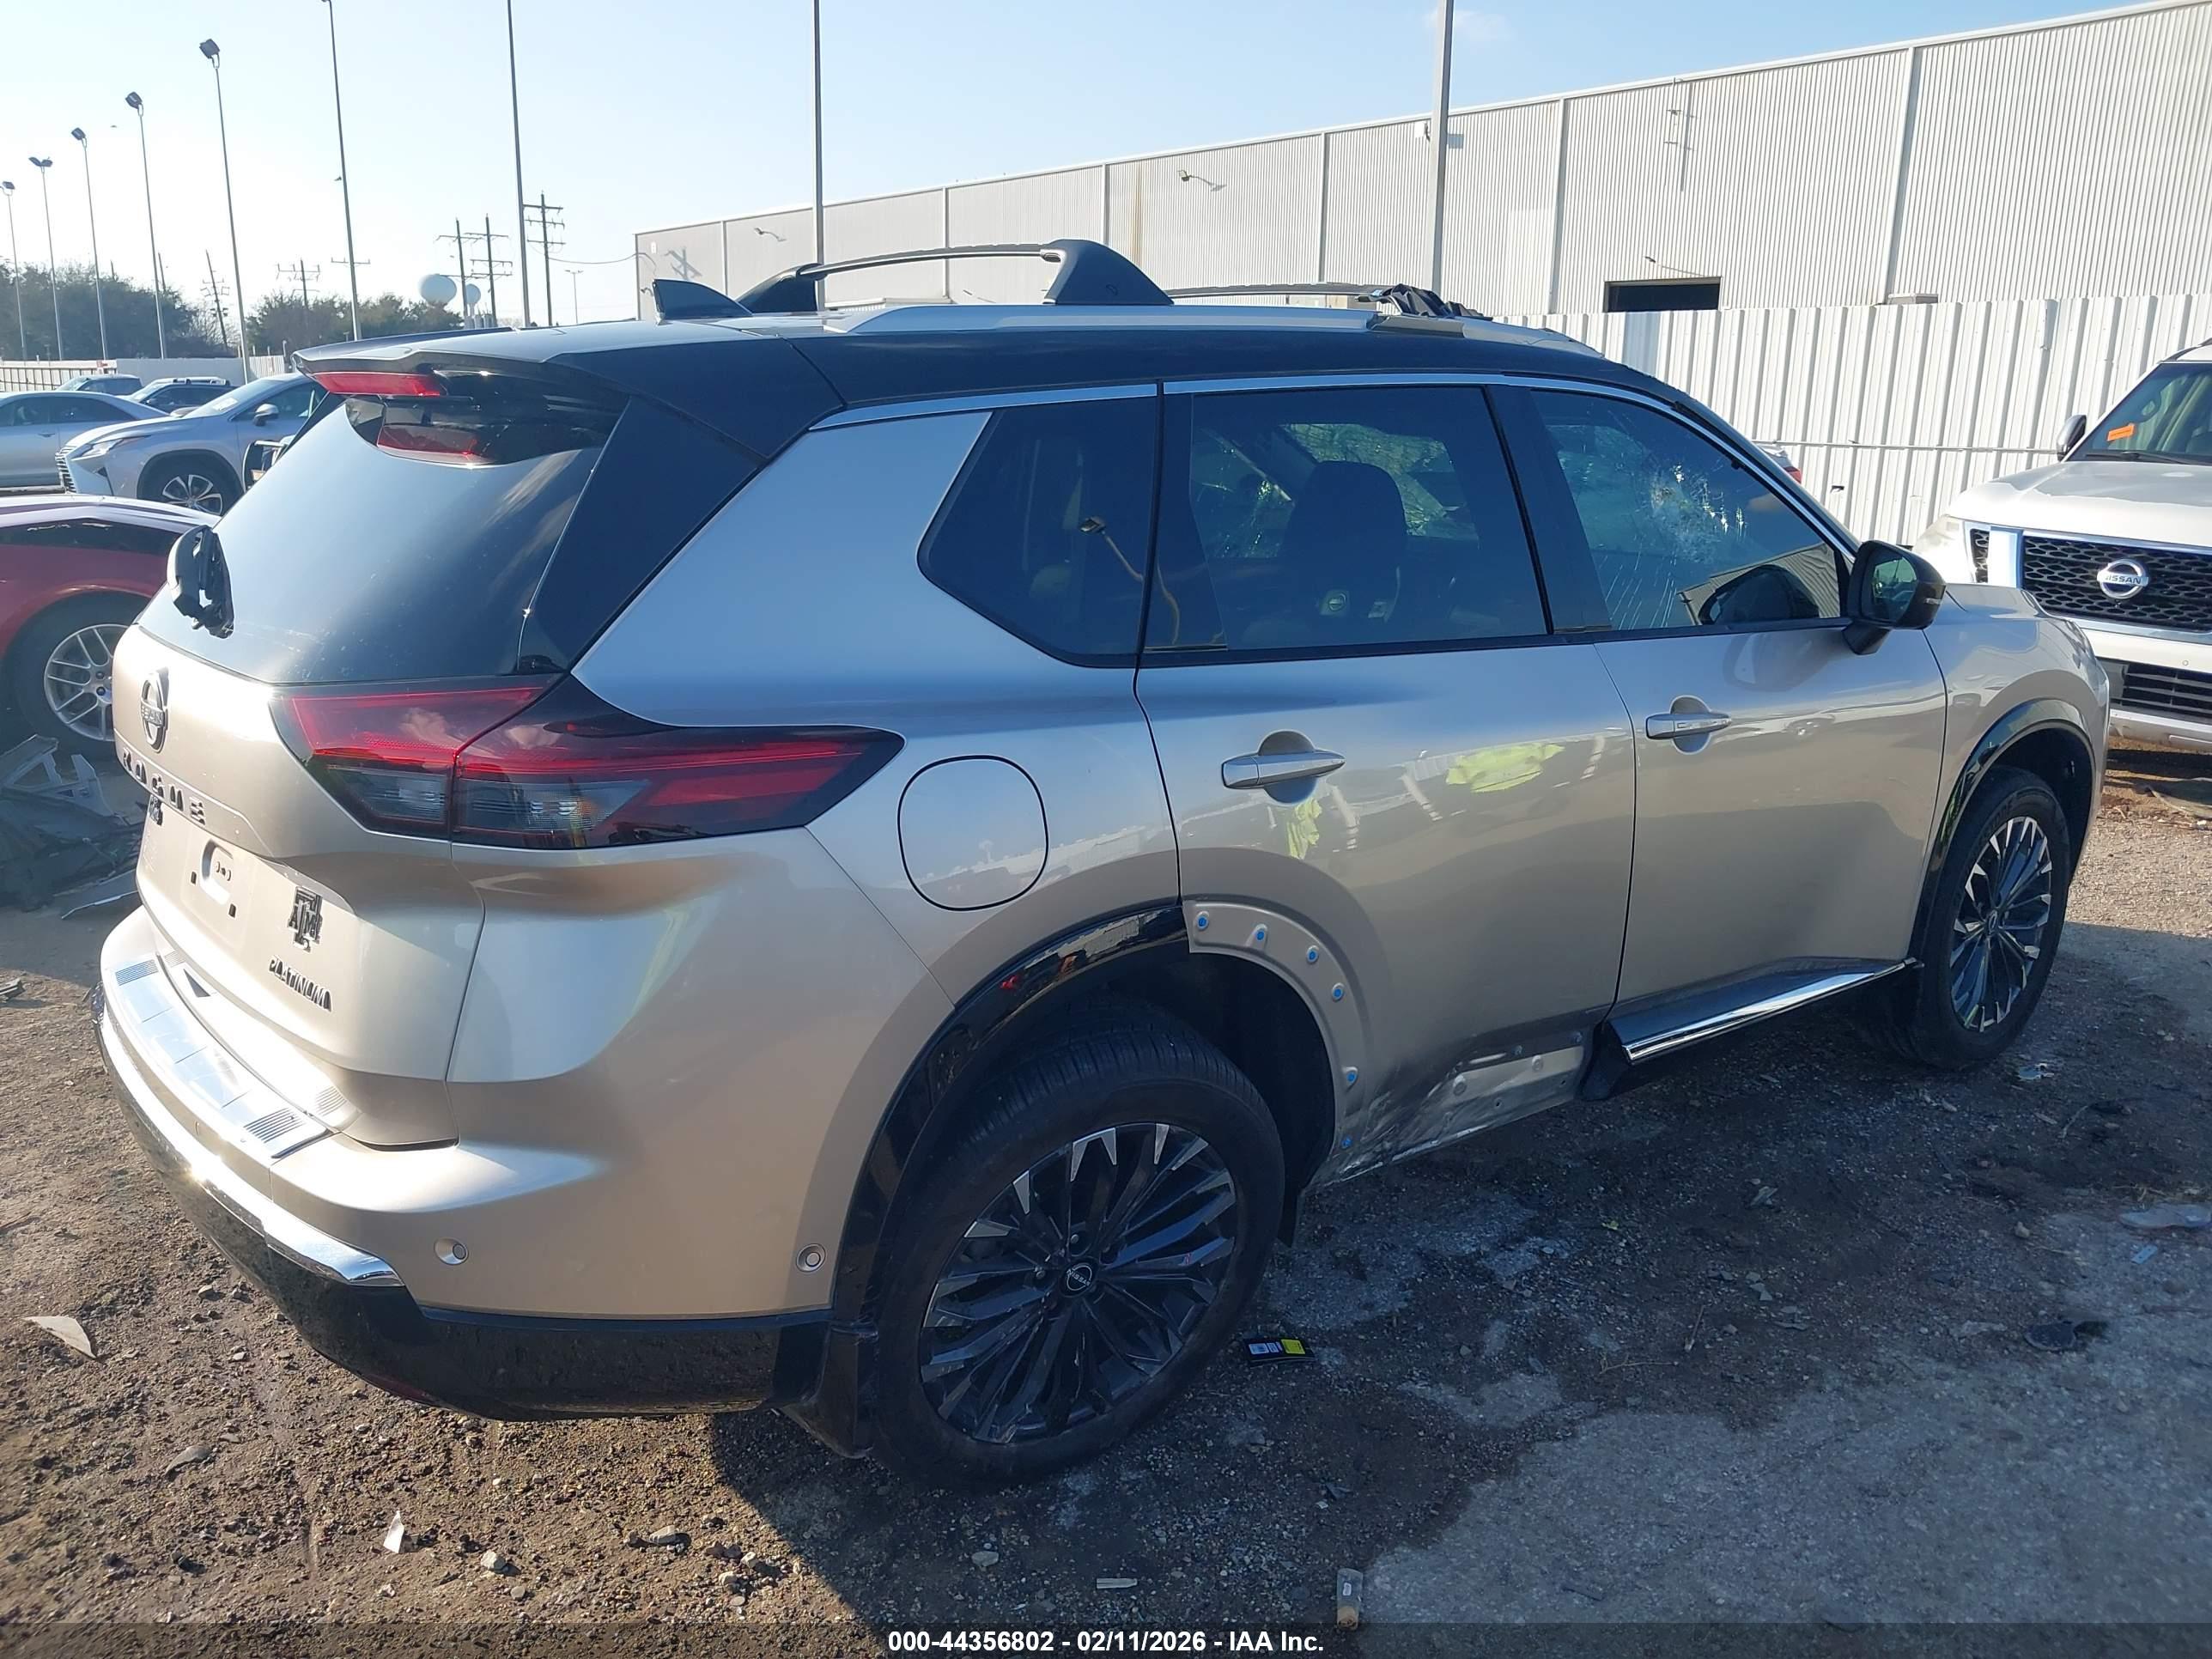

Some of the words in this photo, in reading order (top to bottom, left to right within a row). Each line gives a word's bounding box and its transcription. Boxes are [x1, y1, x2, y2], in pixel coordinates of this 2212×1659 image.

[123, 748, 206, 825] ROGUE
[268, 955, 332, 1013] PLATINUM
[1066, 1268, 1091, 1286] NISSAN
